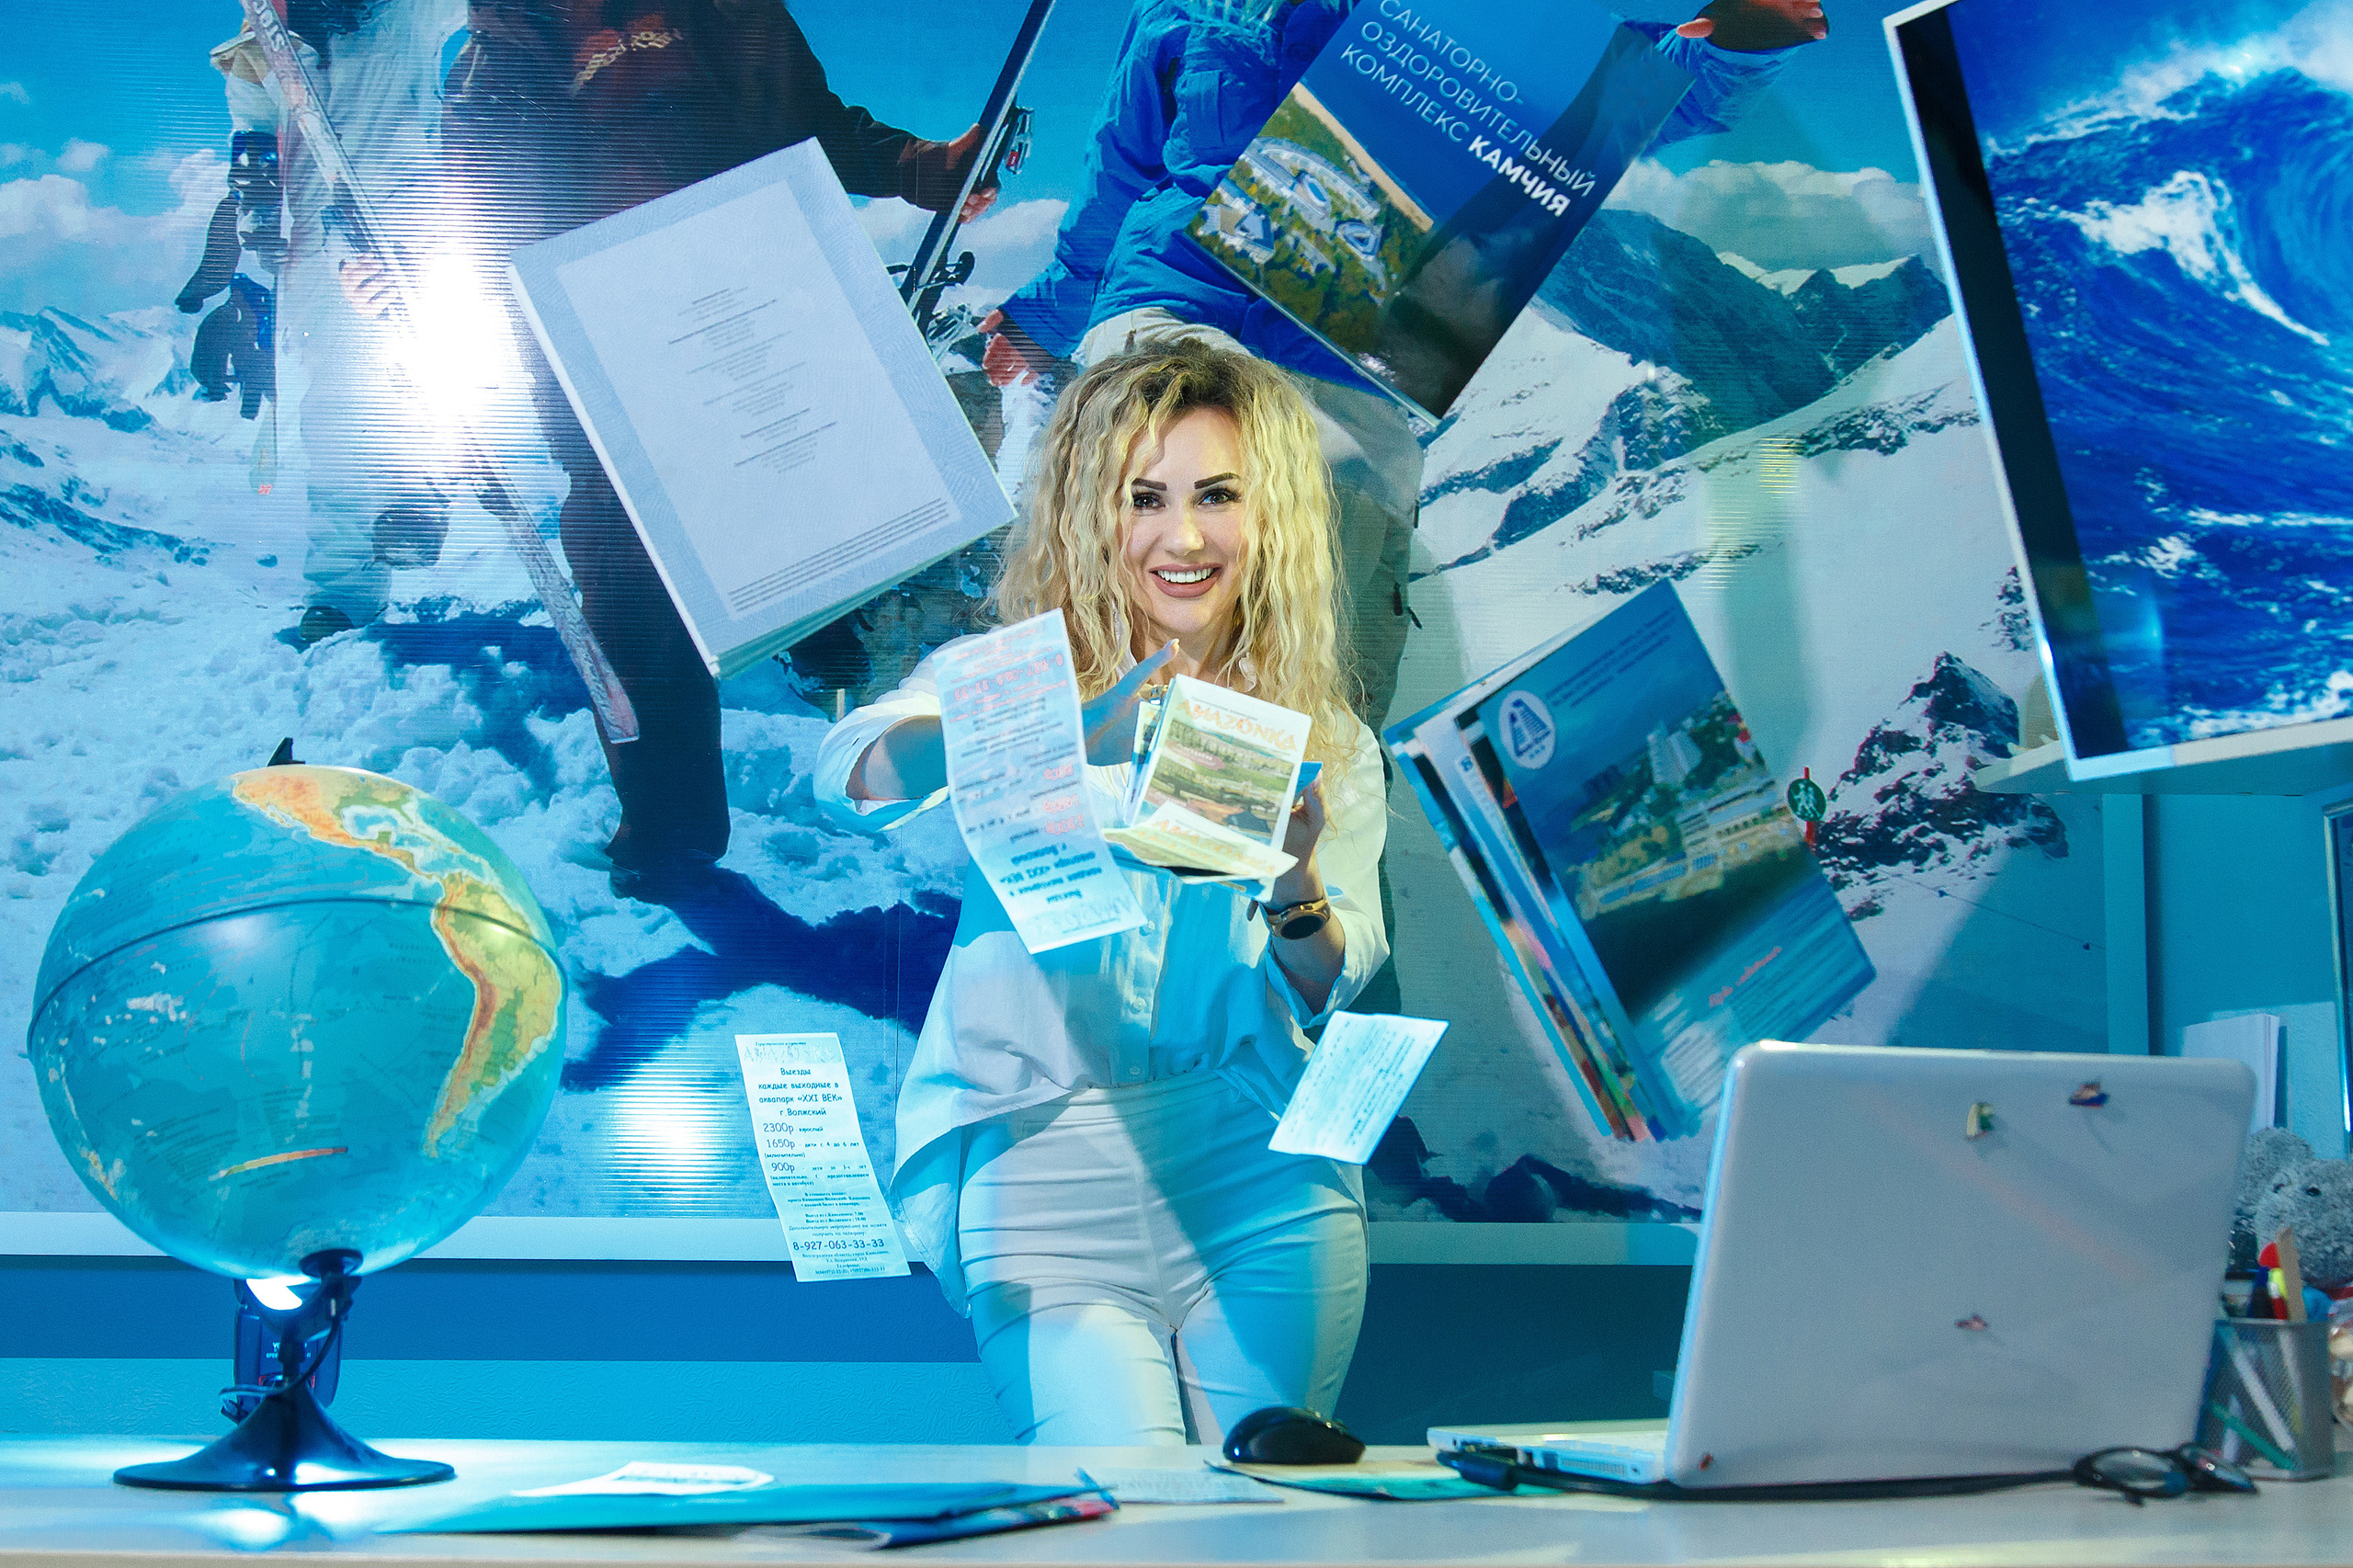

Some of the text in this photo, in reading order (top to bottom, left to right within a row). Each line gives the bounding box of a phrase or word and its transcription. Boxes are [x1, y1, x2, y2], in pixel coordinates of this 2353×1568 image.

[1380, 0, 1524, 105] САНАТОРНО-
[1360, 21, 1597, 198] ОЗДОРОВИТЕЛЬНЫЙ
[1339, 42, 1571, 217] КОМПЛЕКС КАМЧИЯ
[779, 1067, 812, 1075] Выезды
[790, 1082, 832, 1090] выходные
[758, 1095, 794, 1105] аквапарк
[822, 1093, 843, 1102] ВЕК»
[762, 1122, 794, 1135] 2300р
[767, 1139, 796, 1151] 1650р
[770, 1162, 795, 1174] 900р
[792, 1238, 885, 1251] 8-927-063-33-33
